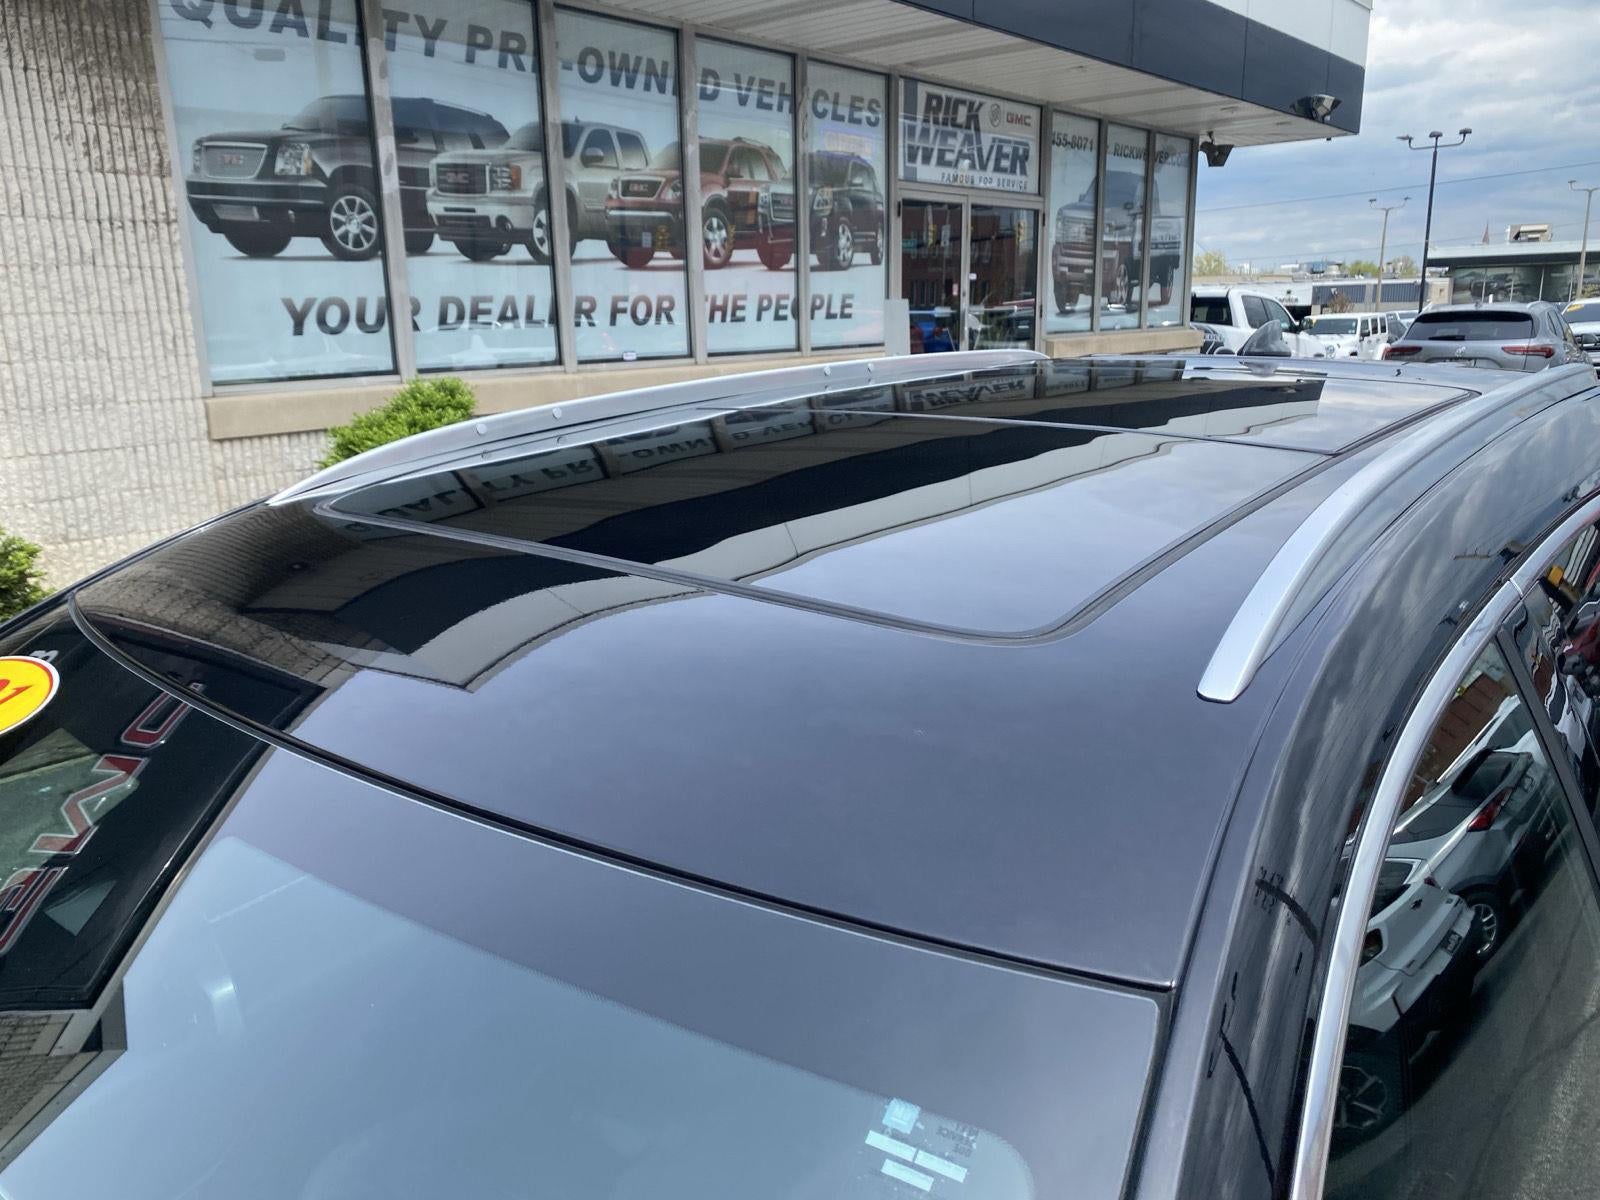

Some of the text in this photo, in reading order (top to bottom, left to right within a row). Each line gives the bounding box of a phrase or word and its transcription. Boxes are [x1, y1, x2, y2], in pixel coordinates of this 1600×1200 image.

[168, 0, 882, 127] QUALTY PR-OWND VEHCLES
[921, 92, 986, 132] RICK
[1006, 111, 1032, 127] GMC
[906, 125, 1030, 177] WEAVER
[941, 172, 1028, 190] FAMOUS FOR SERVICE
[609, 294, 676, 327] FOR
[704, 294, 747, 324] HE
